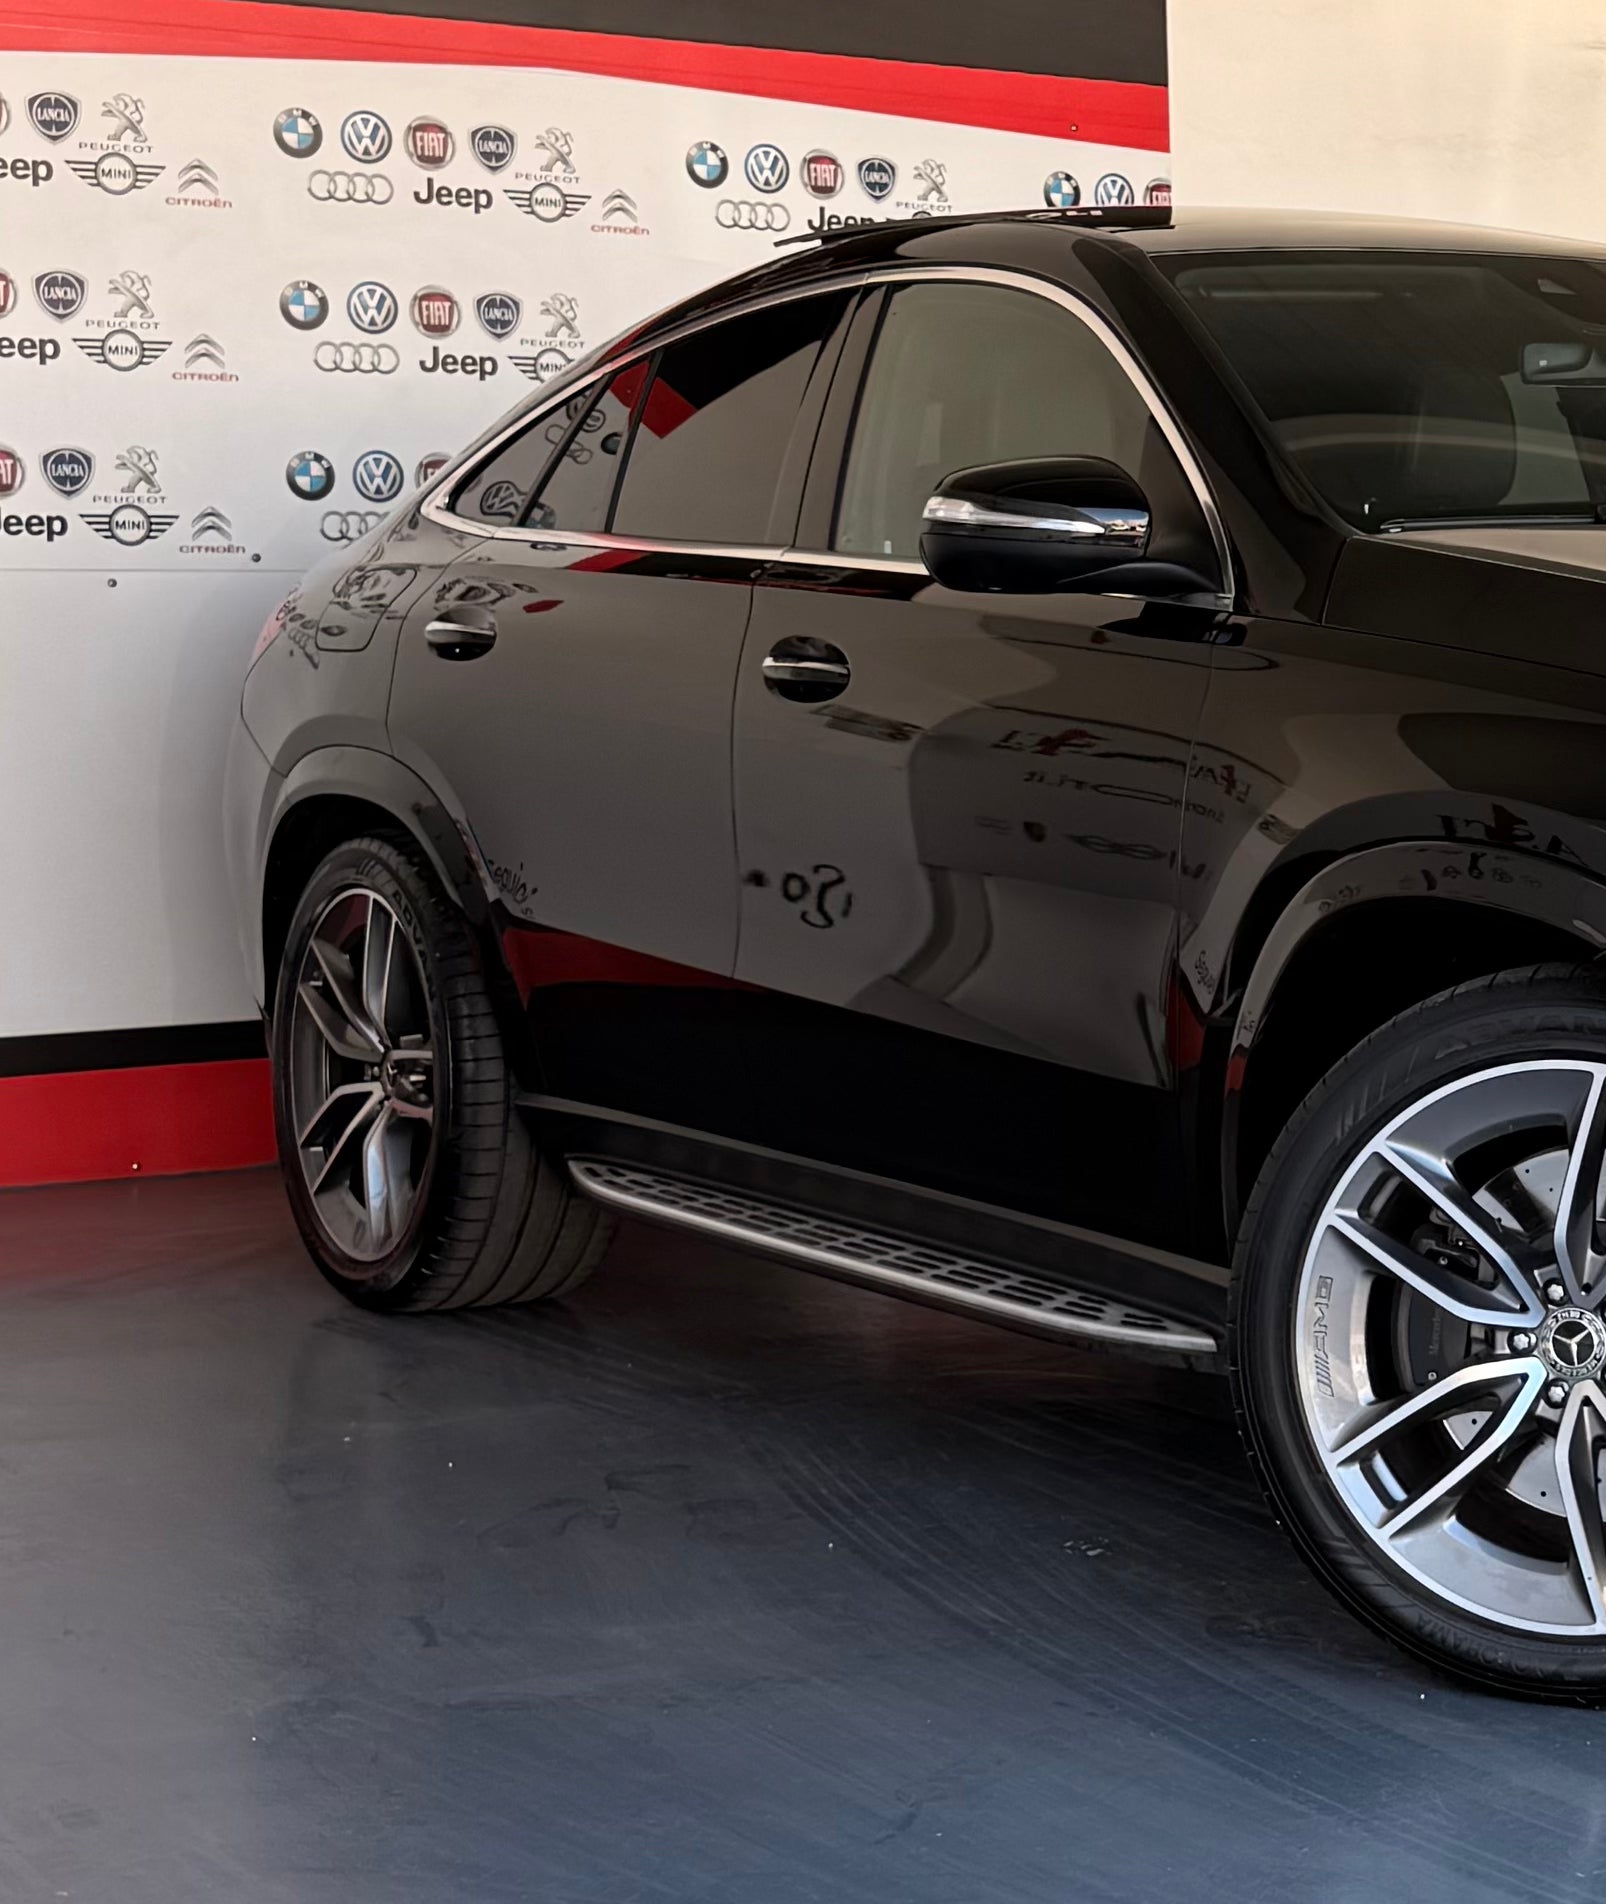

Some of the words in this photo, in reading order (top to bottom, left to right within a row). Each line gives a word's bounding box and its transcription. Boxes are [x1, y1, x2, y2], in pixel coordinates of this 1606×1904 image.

[78, 142, 154, 153] PEUGEOT
[415, 131, 446, 158] FIAT
[101, 168, 132, 180] MINI
[515, 172, 581, 184] PEUGEOT
[809, 163, 837, 187] FIAT
[413, 177, 494, 214] Jeep
[534, 196, 562, 208] MINI
[421, 300, 451, 326] FIAT
[85, 319, 161, 330] PEUGEOT
[108, 345, 139, 356] MINI
[419, 345, 499, 381] Jeep
[539, 362, 566, 373] MIN
[0, 507, 68, 542] eep
[114, 519, 146, 530] MINI
